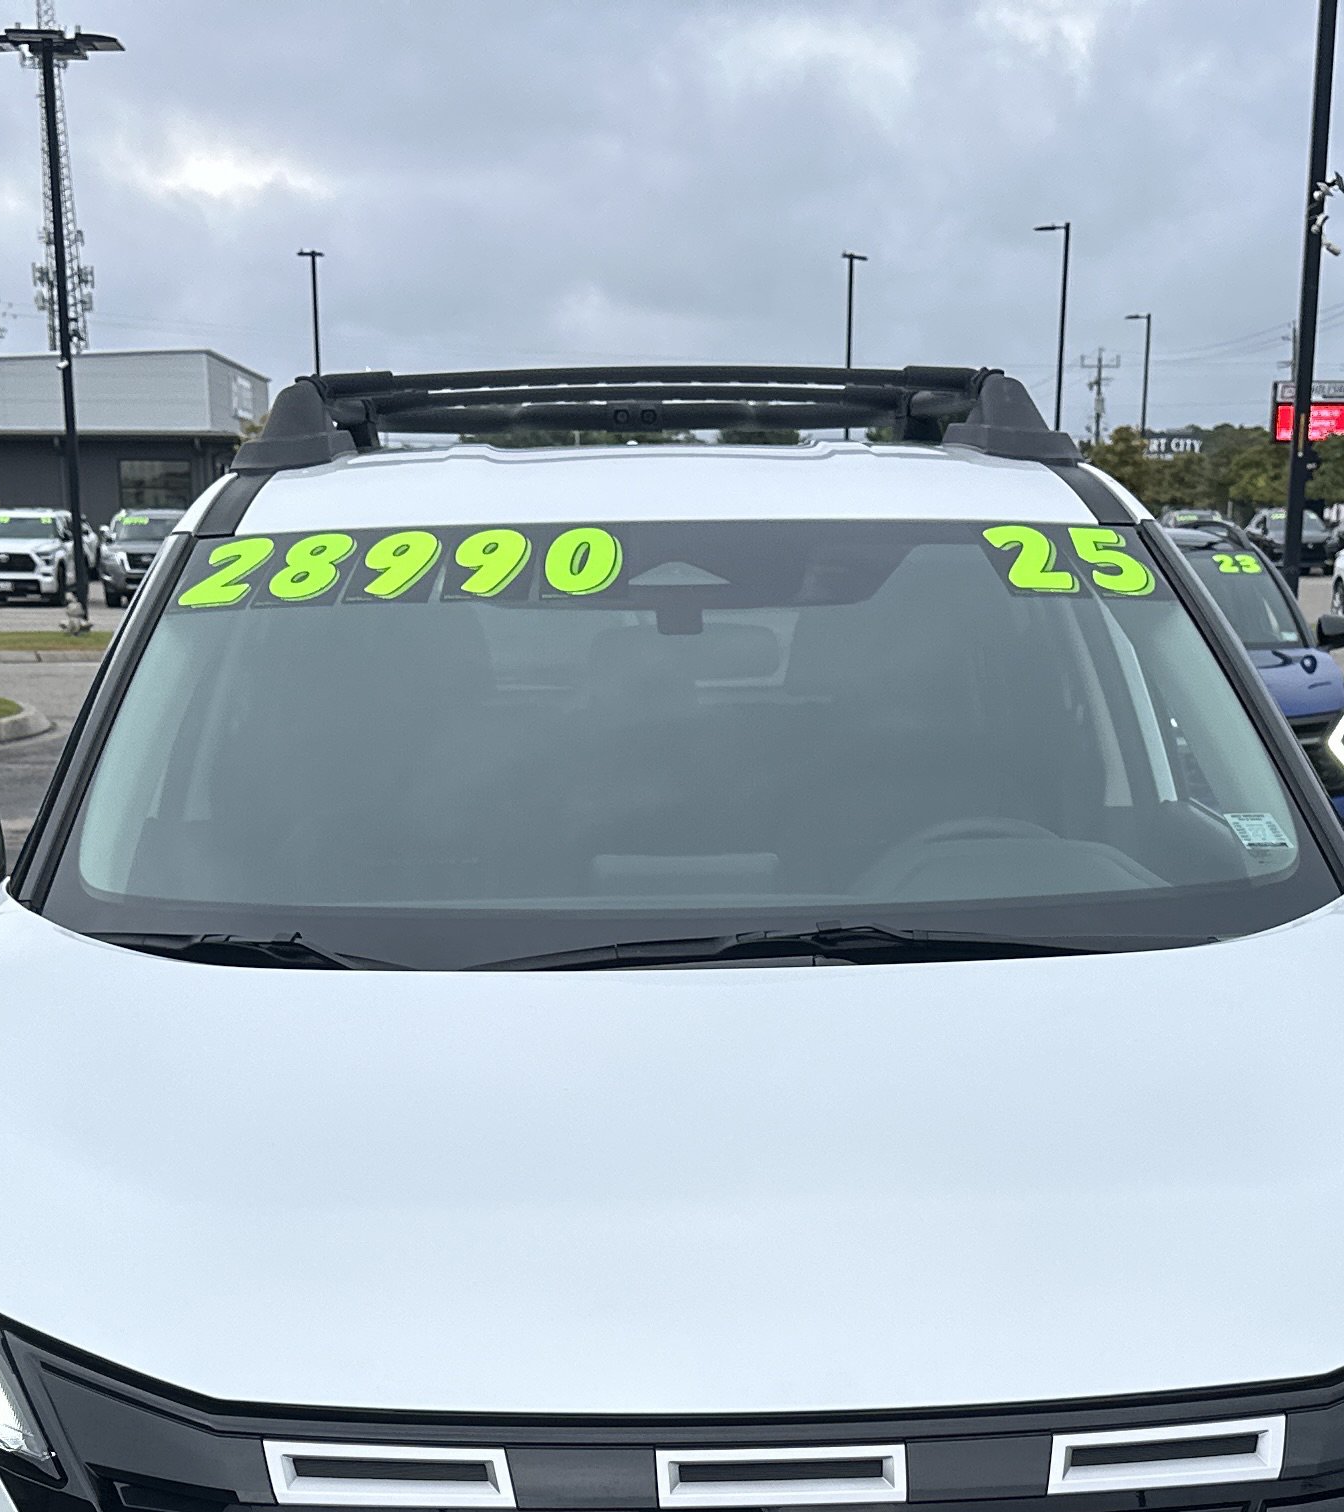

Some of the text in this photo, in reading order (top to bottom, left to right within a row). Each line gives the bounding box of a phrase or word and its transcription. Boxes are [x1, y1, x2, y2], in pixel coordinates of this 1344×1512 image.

[1170, 437, 1203, 454] CITY
[177, 524, 1157, 609] 28990 25
[1212, 553, 1262, 575] 23
